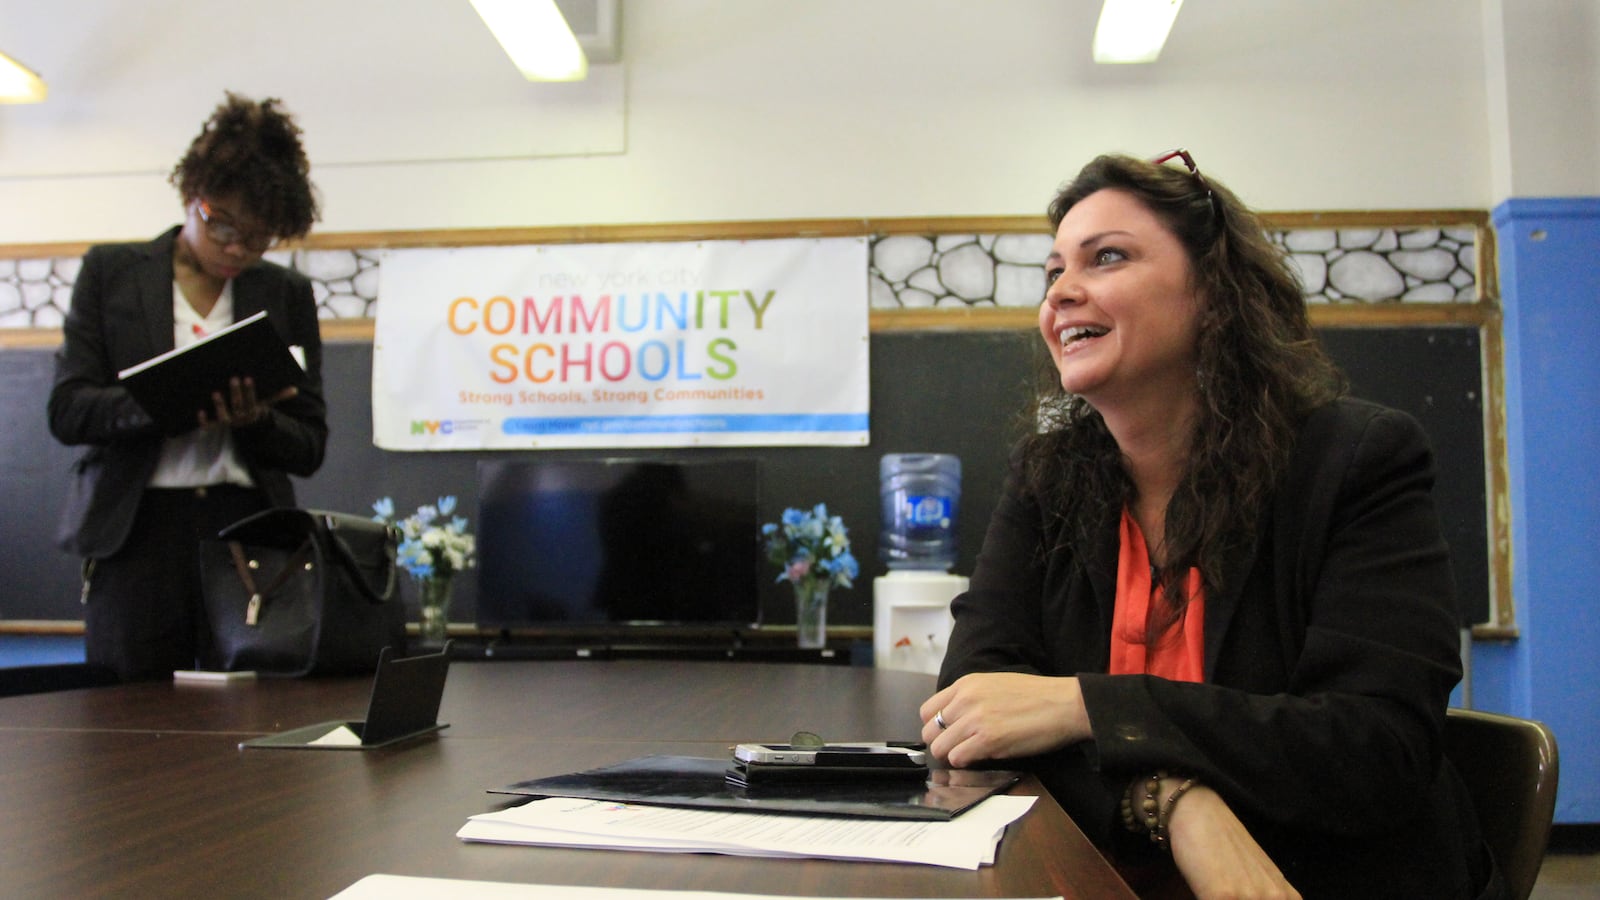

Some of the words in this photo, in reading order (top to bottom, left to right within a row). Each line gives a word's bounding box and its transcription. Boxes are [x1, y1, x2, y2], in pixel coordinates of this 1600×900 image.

[538, 273, 588, 288] new
[598, 269, 648, 290] york
[657, 266, 704, 289] city
[447, 289, 776, 336] COMMUNITY
[488, 337, 739, 385] SCHOOLS
[458, 390, 513, 406] Strong
[518, 389, 587, 405] Schools,
[592, 388, 648, 405] Strong
[653, 386, 765, 402] Communities
[410, 419, 454, 435] NYC
